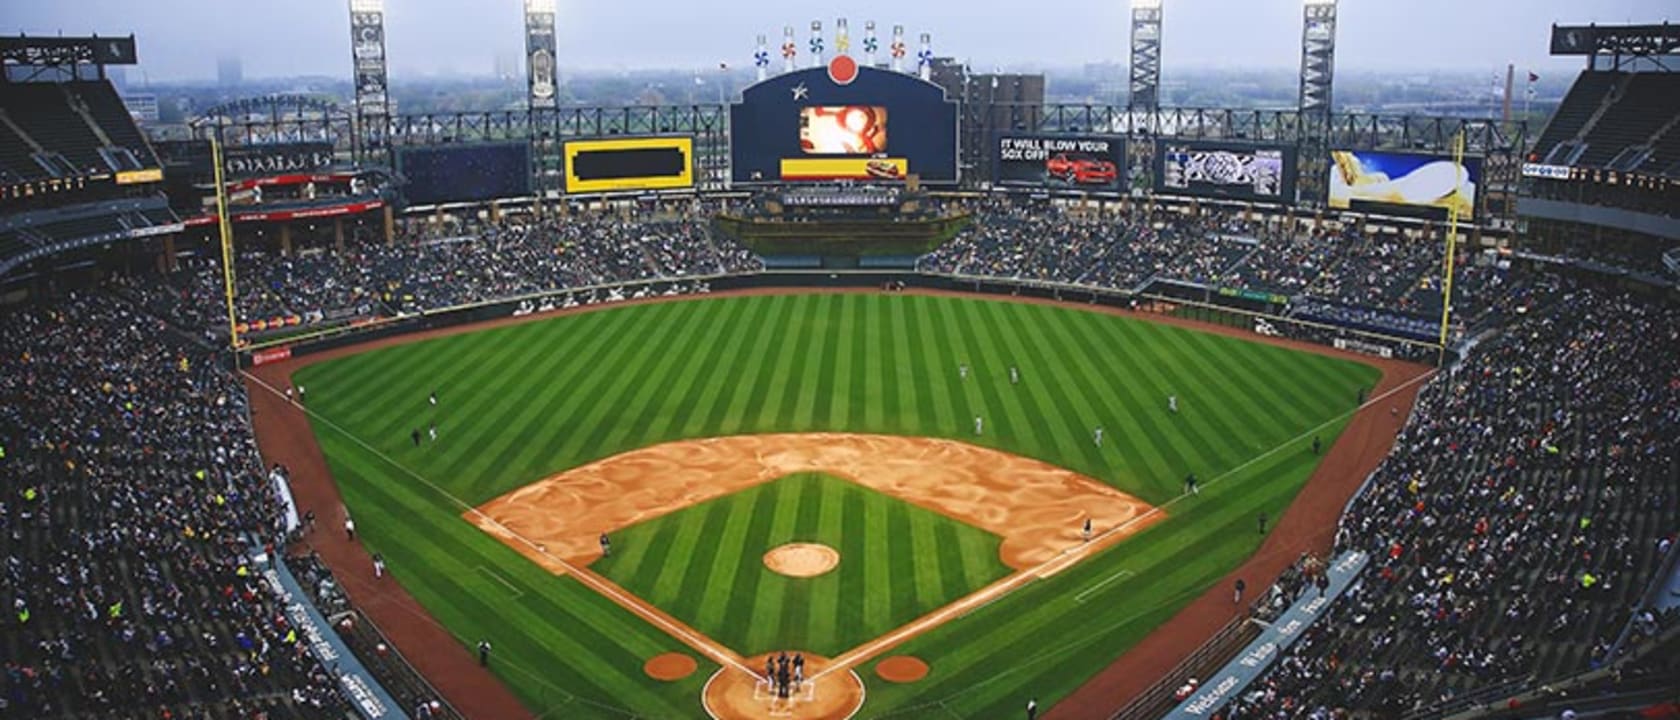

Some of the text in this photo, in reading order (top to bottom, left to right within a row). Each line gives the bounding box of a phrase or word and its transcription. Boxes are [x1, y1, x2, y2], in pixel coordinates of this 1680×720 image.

[1001, 138, 1109, 153] IT WILL BLOW YOUR
[1001, 150, 1022, 160] SOX
[1184, 673, 1241, 718] Welcome
